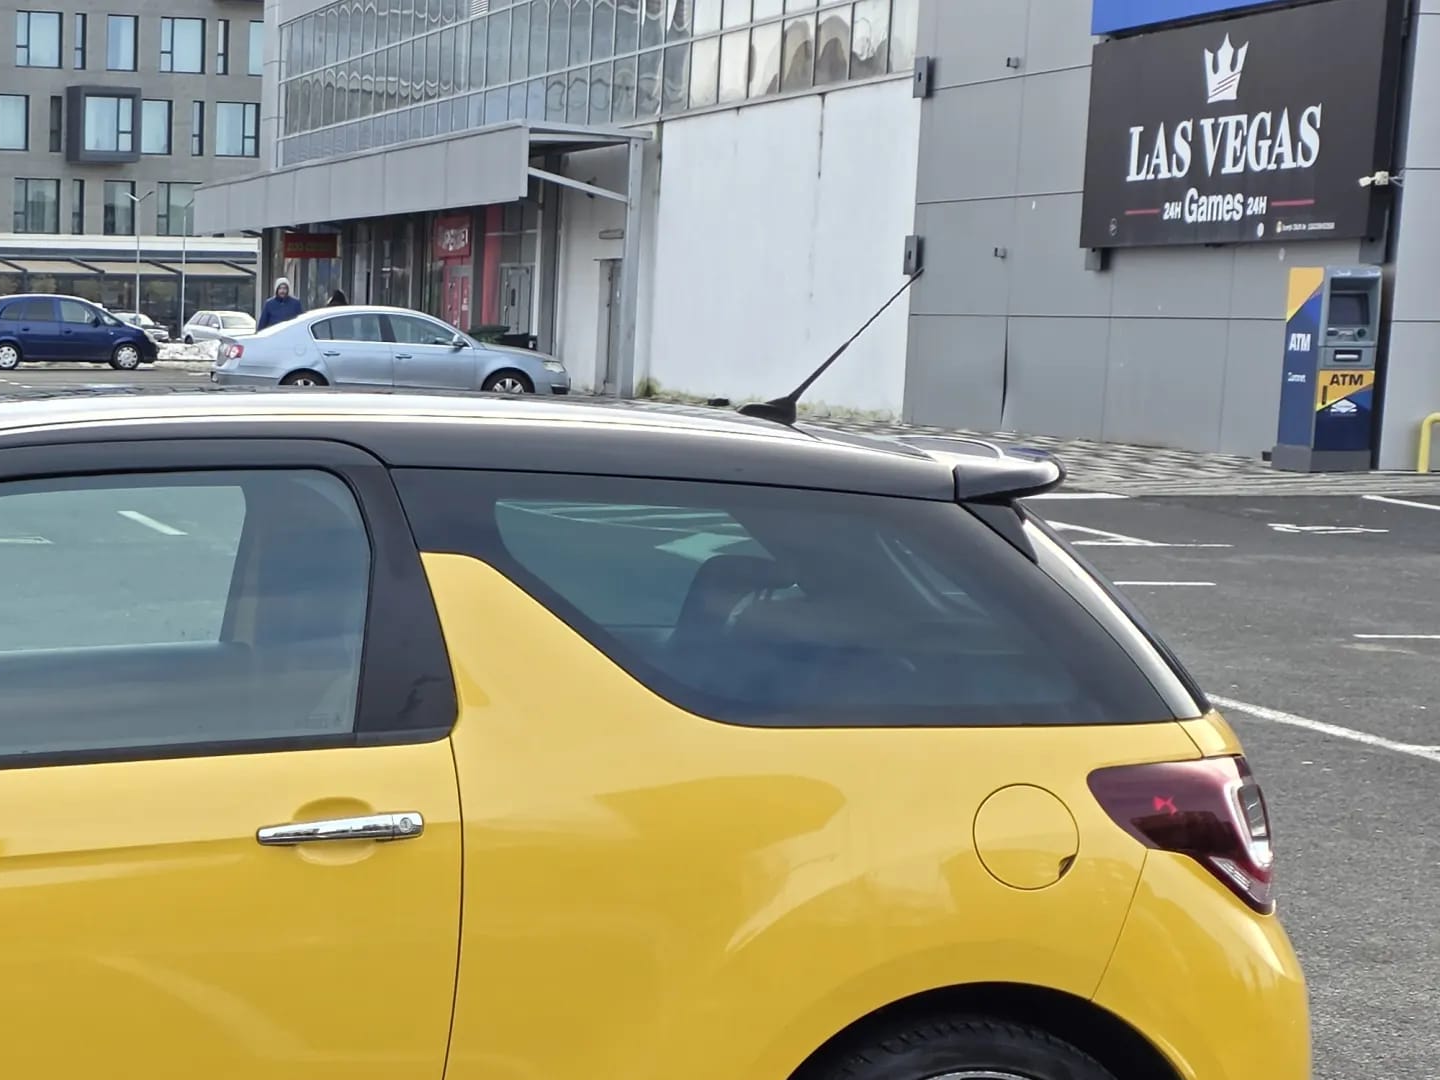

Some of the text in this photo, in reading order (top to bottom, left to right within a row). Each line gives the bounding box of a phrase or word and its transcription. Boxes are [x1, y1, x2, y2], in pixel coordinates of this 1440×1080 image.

[1126, 103, 1322, 182] LAS VEGAS
[1163, 187, 1267, 223] 24H Games 24H
[1288, 333, 1311, 352] ATM
[1329, 374, 1364, 386] ATM
